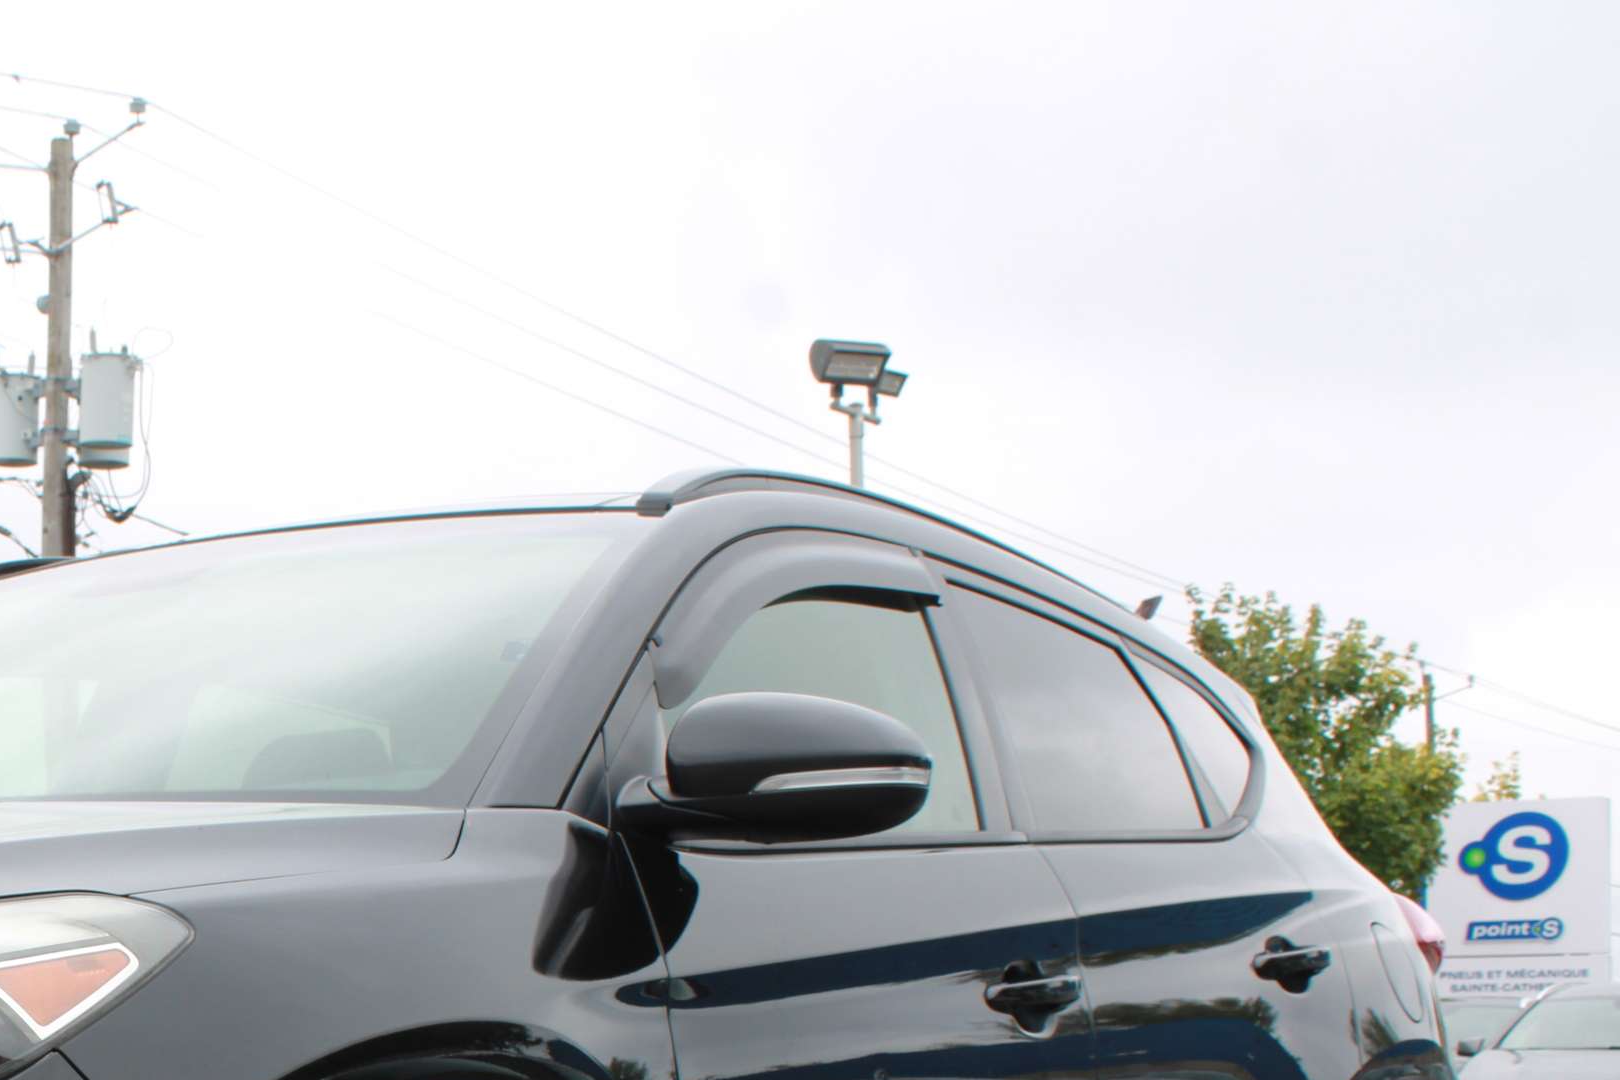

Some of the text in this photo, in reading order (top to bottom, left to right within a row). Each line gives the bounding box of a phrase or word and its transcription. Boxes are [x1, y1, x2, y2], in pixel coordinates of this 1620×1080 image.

[1491, 824, 1552, 885] S
[1439, 967, 1590, 980] PNEUS ET MÉCANIQUE
